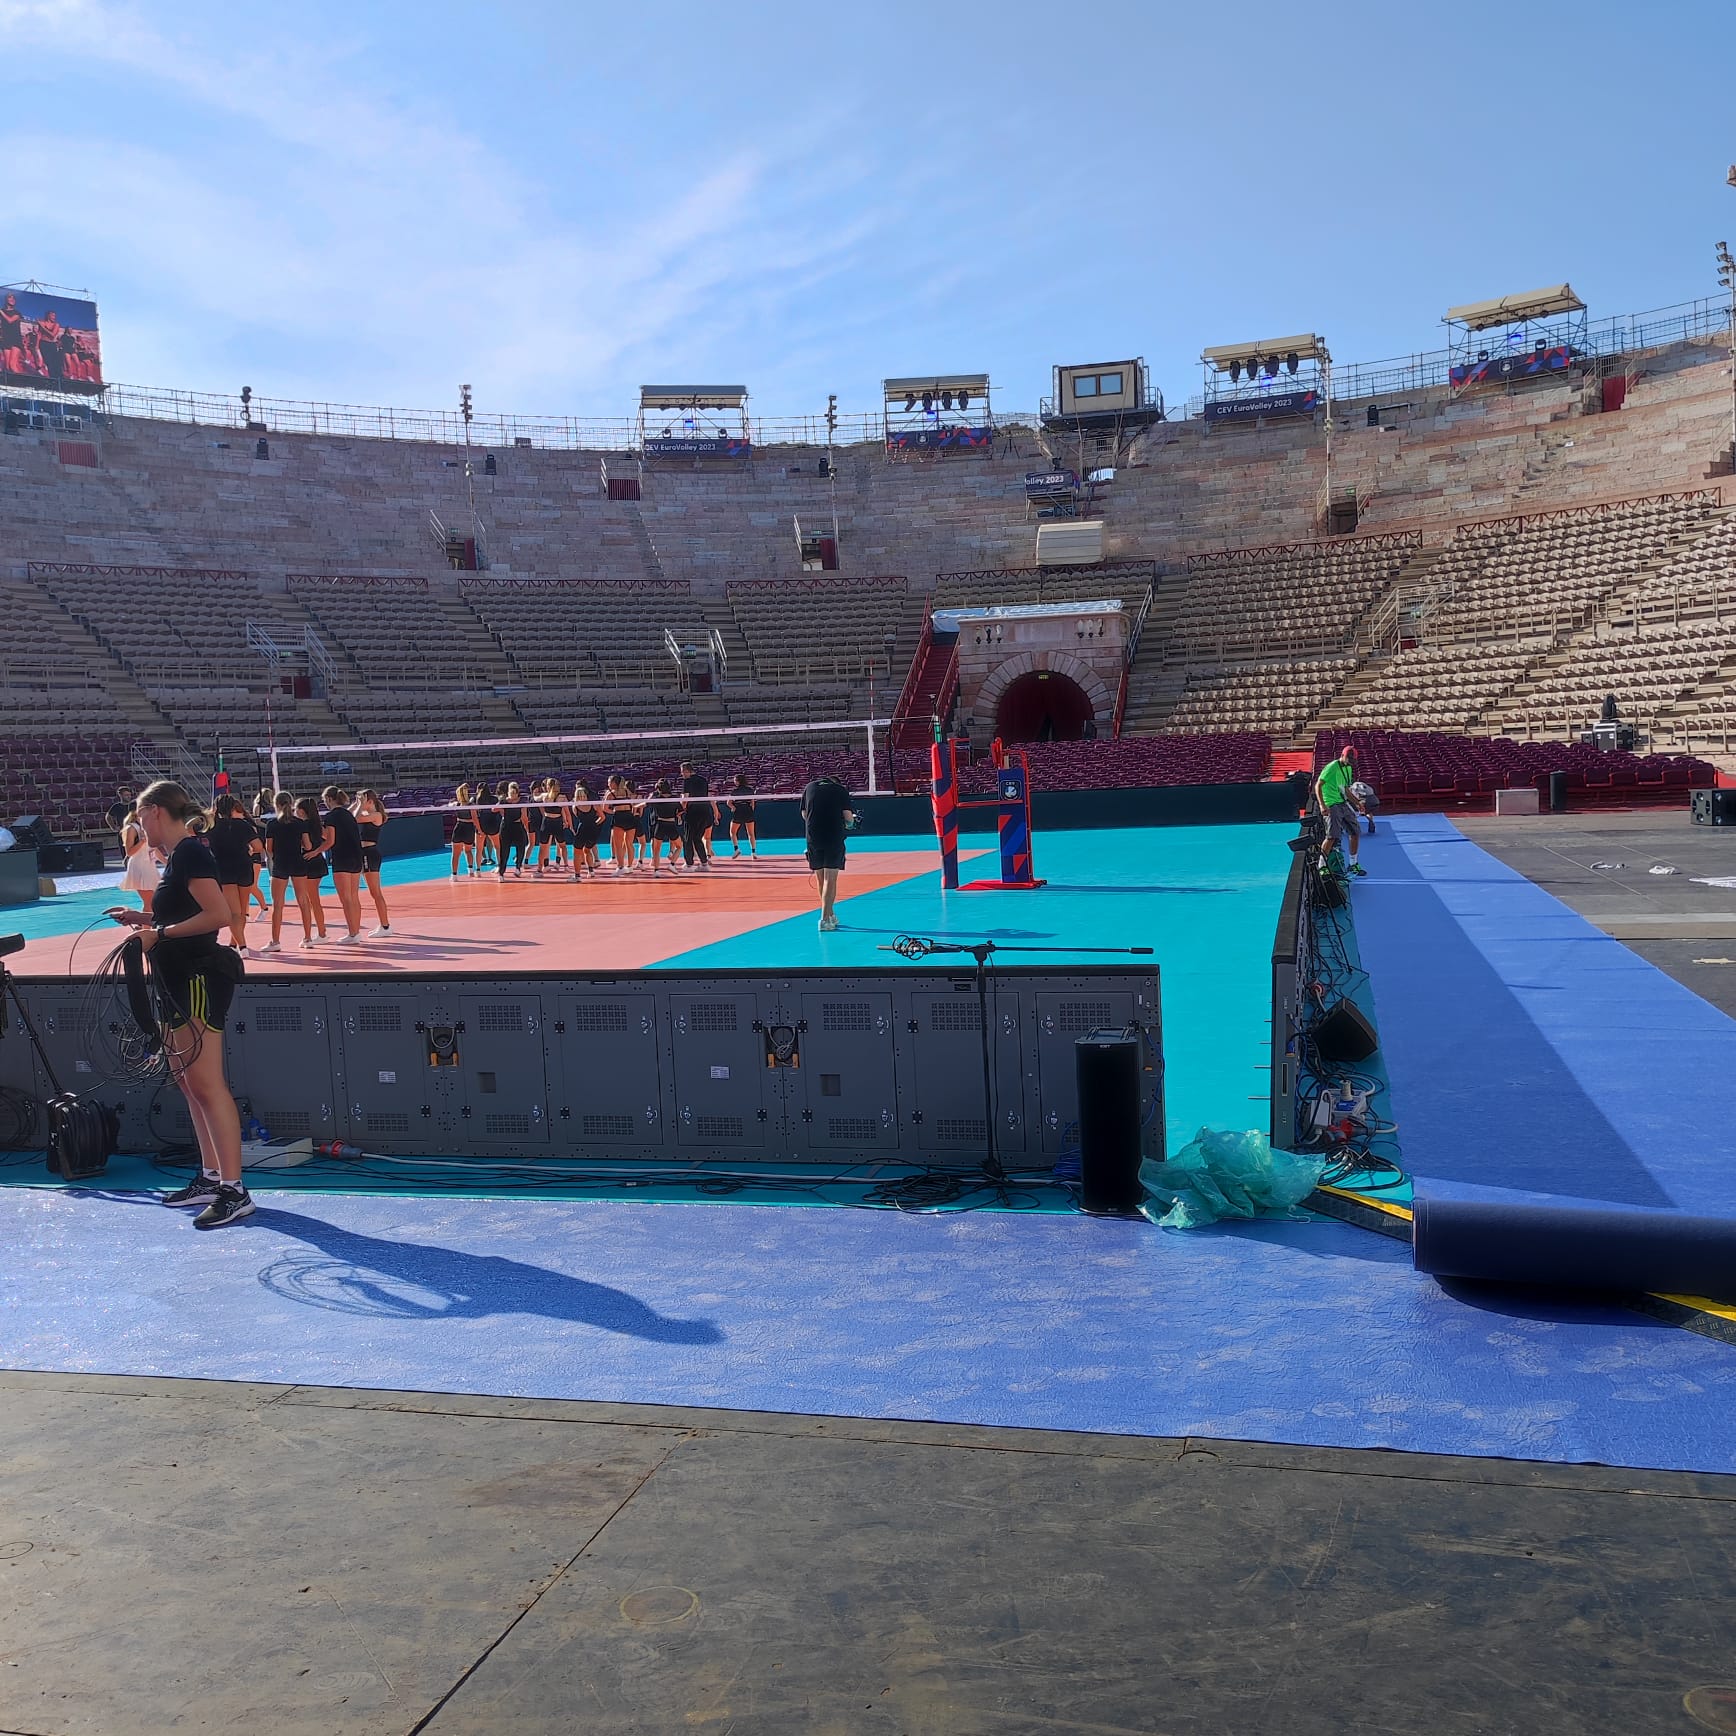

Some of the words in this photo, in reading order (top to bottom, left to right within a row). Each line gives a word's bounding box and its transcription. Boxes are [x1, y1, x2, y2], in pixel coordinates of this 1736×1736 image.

[1217, 406, 1232, 414] CEV
[1233, 401, 1273, 412] EuroVolley
[1274, 398, 1292, 408] 2023
[660, 443, 698, 453] EuroVolley
[699, 443, 716, 451] 2023
[1024, 477, 1044, 486] olley
[1045, 475, 1064, 484] 2023
